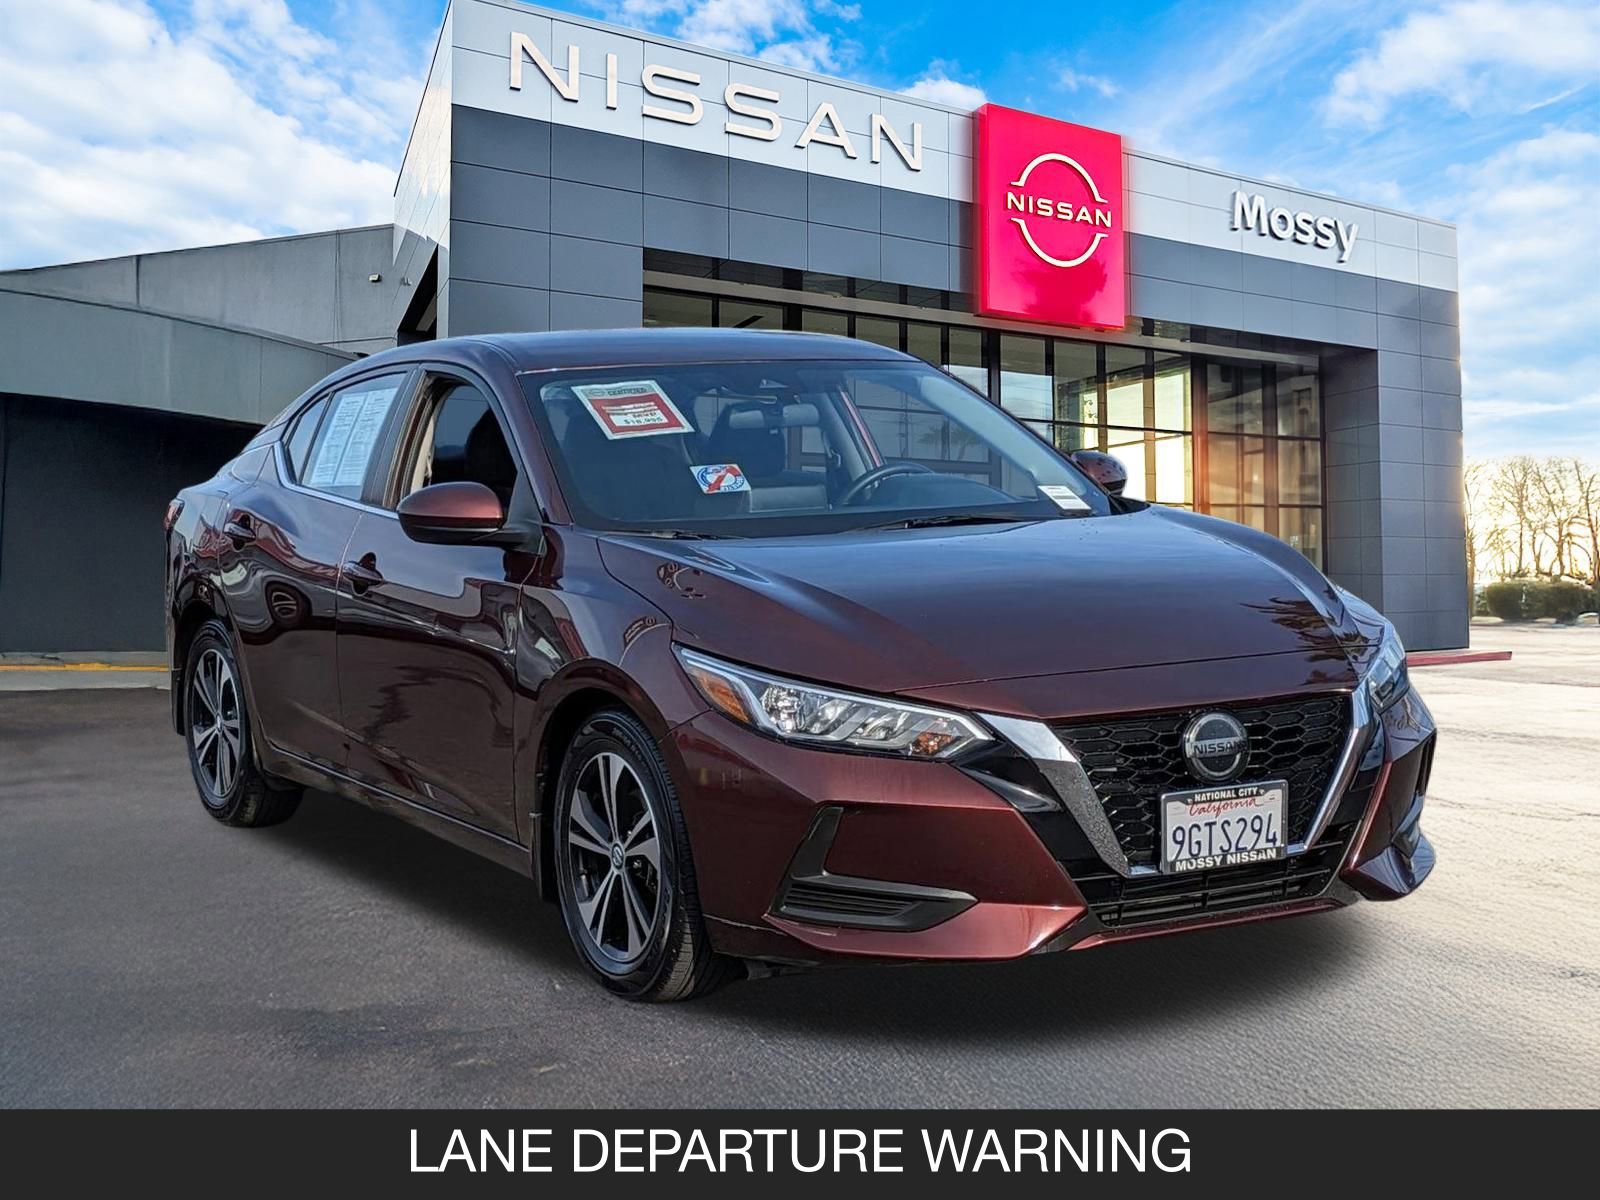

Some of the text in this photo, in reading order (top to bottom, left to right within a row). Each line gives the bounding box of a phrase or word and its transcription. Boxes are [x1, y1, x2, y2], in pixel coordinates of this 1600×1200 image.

[509, 31, 923, 171] NISSAN
[1006, 191, 1112, 228] NISSAN
[1231, 190, 1360, 263] Mossy
[1193, 740, 1247, 756] NISSAN
[1189, 798, 1264, 819] California
[1194, 787, 1258, 802] NATIONAL CITY
[1172, 813, 1278, 861] 9GTS294
[1175, 848, 1277, 872] MOSSY NISSAN
